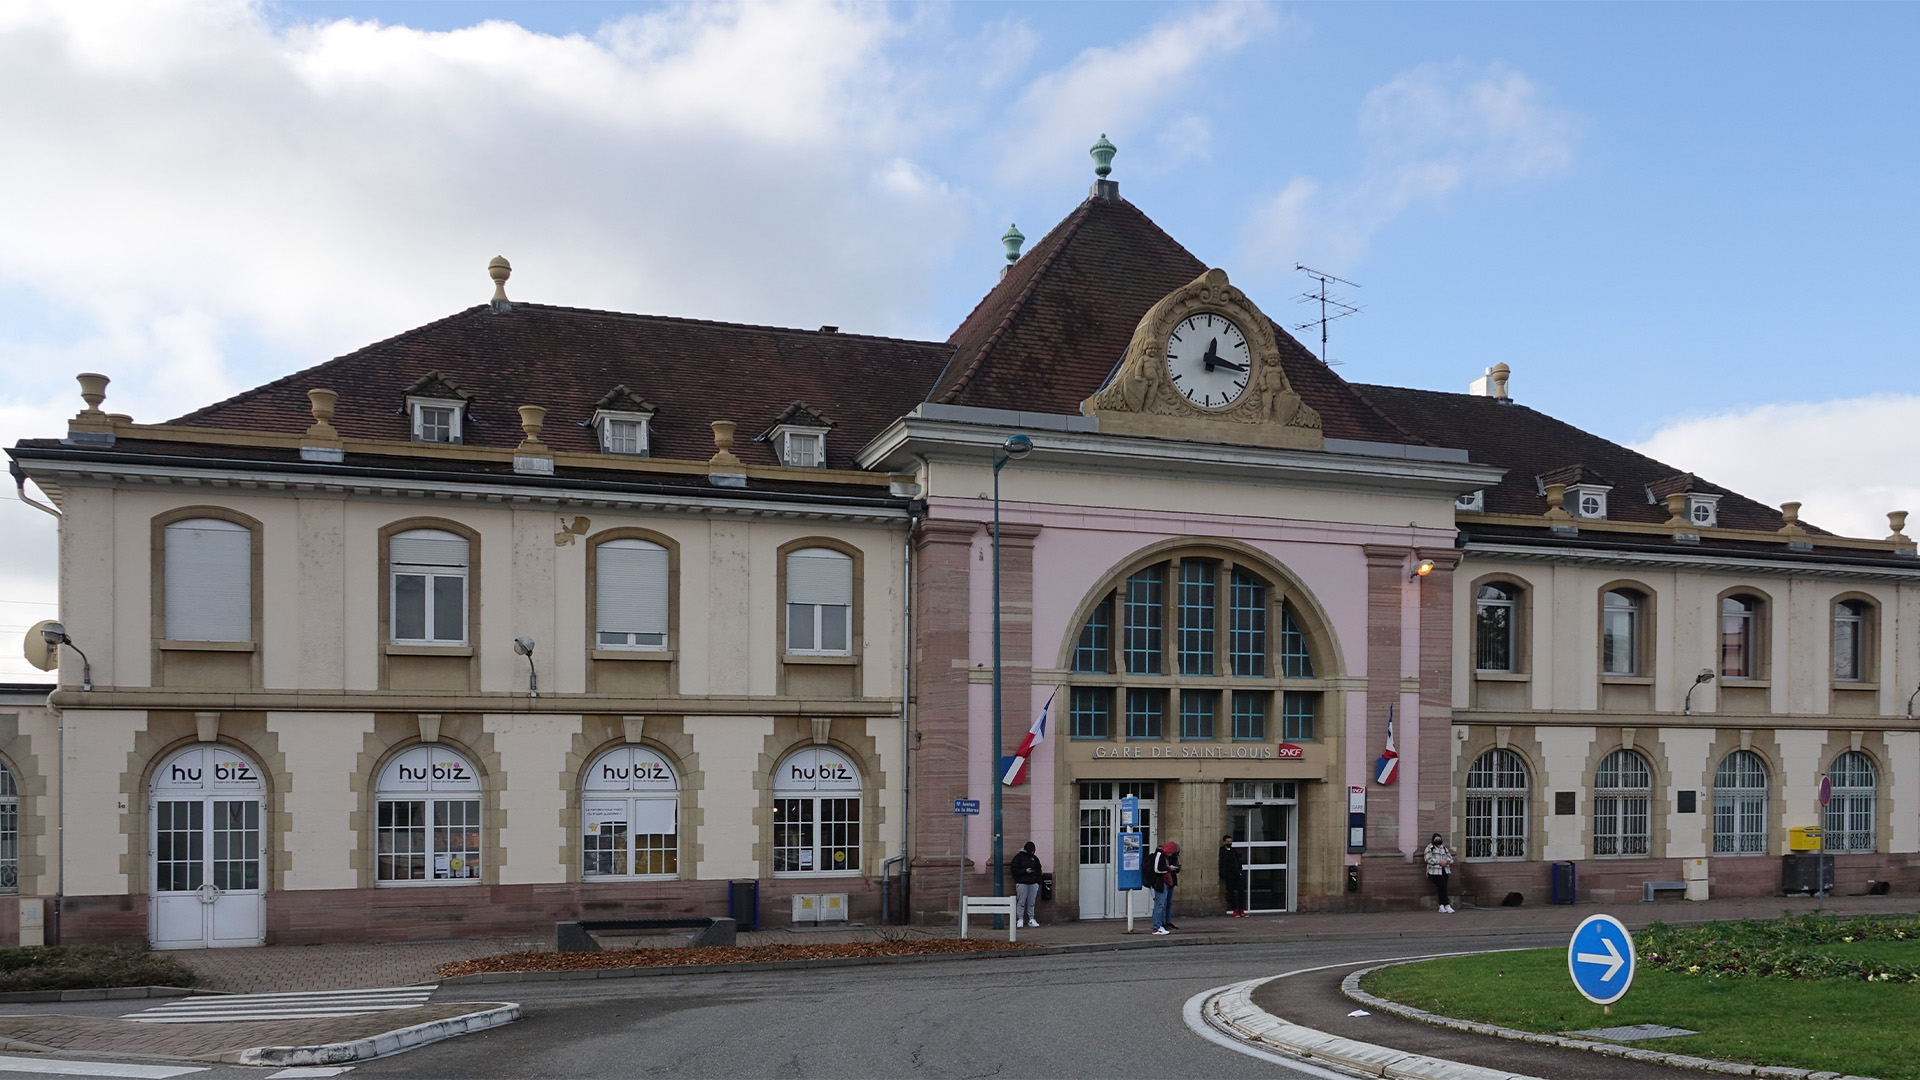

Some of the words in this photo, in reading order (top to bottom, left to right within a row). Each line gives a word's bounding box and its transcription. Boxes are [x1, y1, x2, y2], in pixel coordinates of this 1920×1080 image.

[1095, 746, 1141, 758] GARE
[1152, 746, 1172, 758] DE
[1182, 746, 1271, 758] SAINT-LOUIS
[1279, 748, 1302, 757] SNCF
